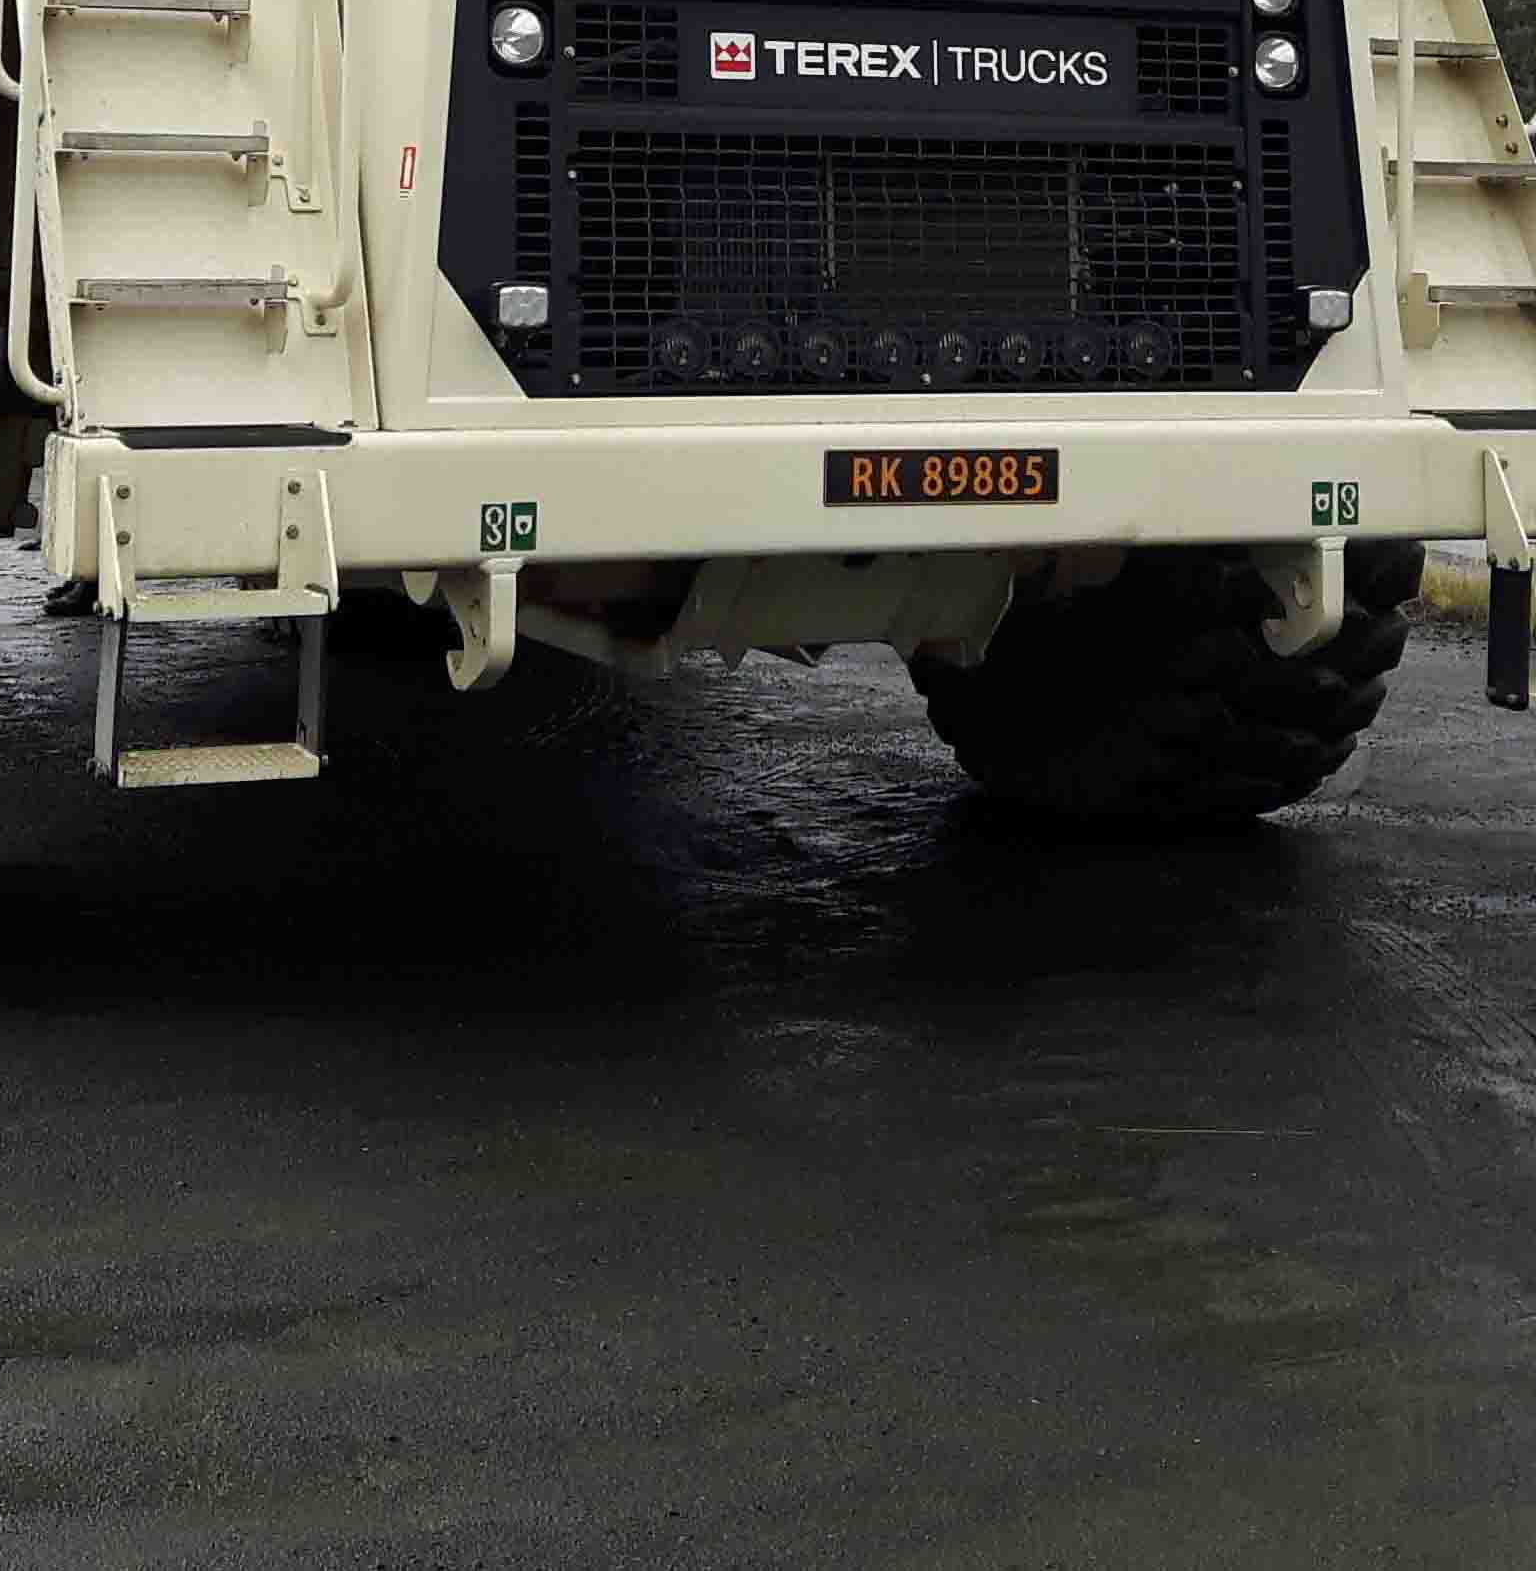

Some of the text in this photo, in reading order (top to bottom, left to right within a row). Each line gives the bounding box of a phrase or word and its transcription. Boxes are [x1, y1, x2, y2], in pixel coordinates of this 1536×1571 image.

[764, 40, 1108, 86] TEREX TRUCKS
[852, 456, 1043, 497] RK 89885
